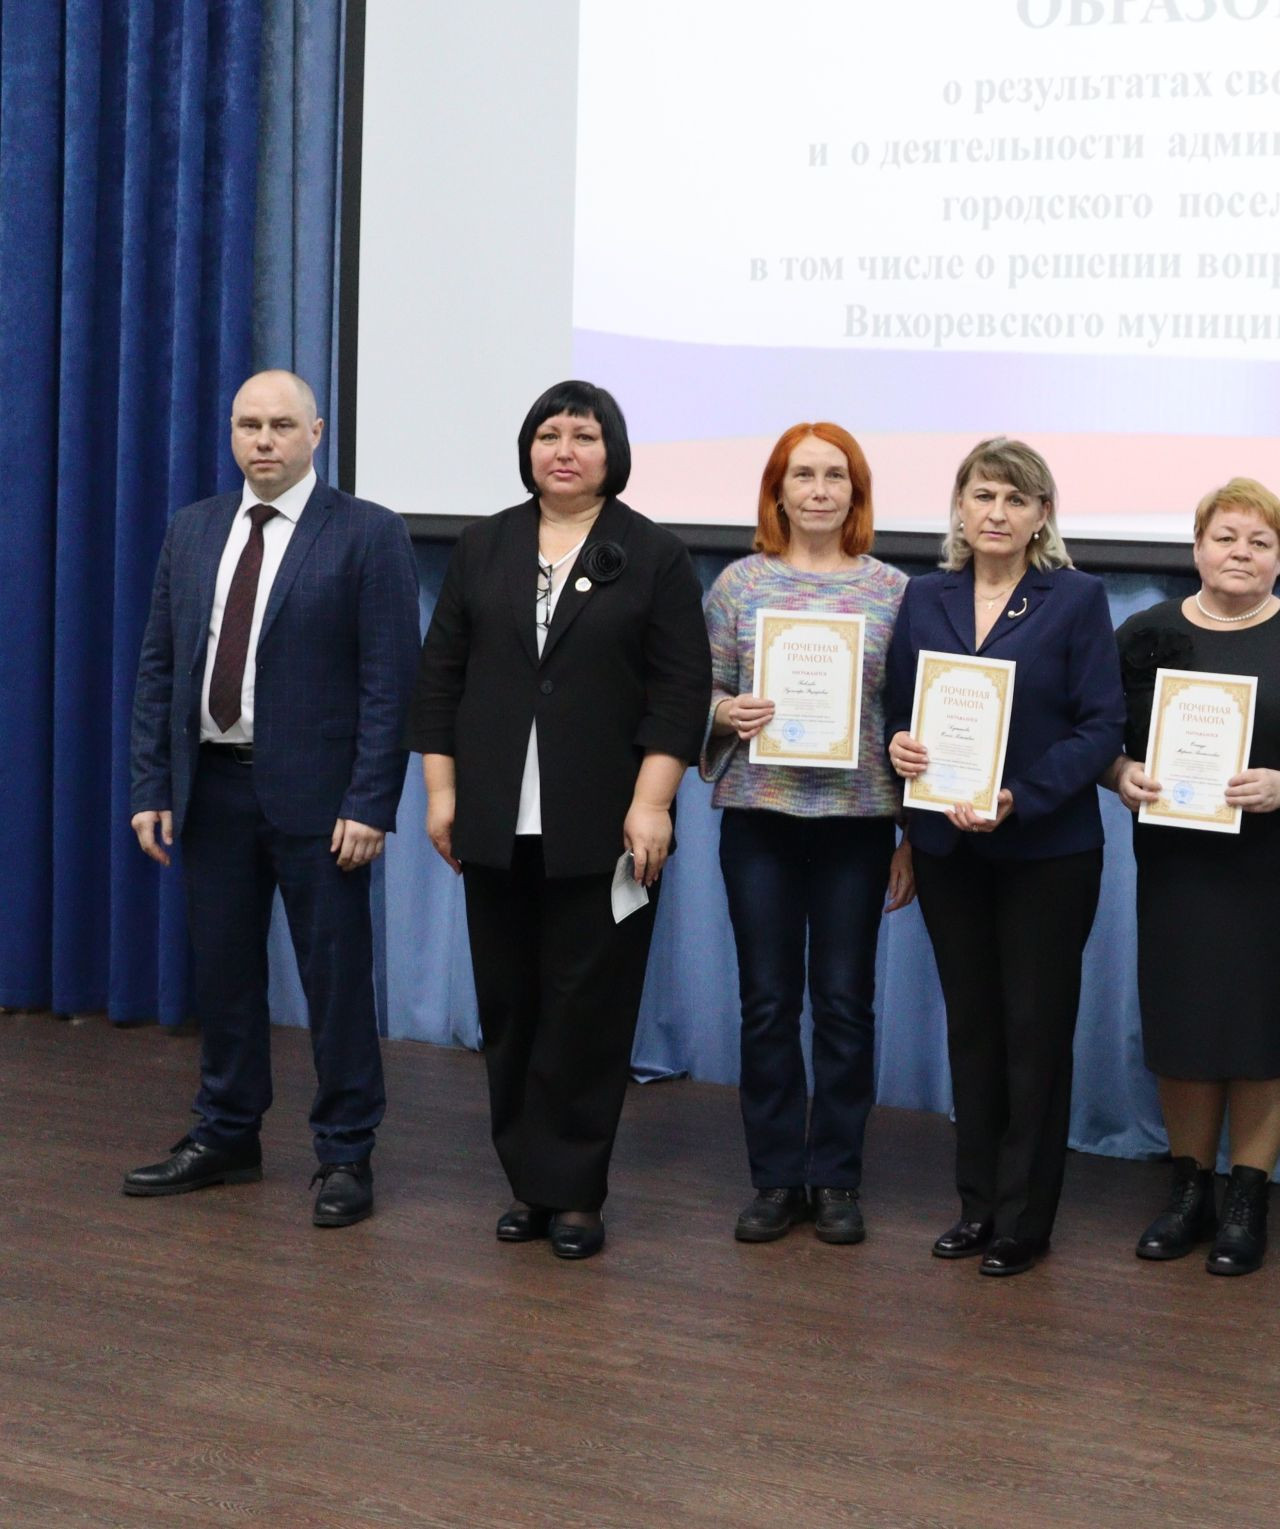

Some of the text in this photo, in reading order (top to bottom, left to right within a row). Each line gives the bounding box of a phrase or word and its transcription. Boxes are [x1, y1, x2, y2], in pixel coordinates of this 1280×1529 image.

[942, 80, 963, 106] о
[973, 71, 1213, 114] результатах
[808, 142, 829, 167] и
[850, 140, 871, 166] о
[880, 130, 1145, 170] деятельности
[942, 191, 1155, 231] городского
[749, 257, 769, 282] в
[780, 256, 845, 282] том
[857, 253, 966, 281] числе
[974, 254, 996, 280] о
[1007, 252, 1182, 290] решении
[843, 303, 1106, 348] Вихоревского
[783, 641, 839, 653] ПОЧЕТНАЯ
[787, 653, 833, 664] ГРАМОТА
[1178, 702, 1232, 716] ПОЧЕТНАЯ
[1181, 714, 1226, 726] ГРАМОТА
